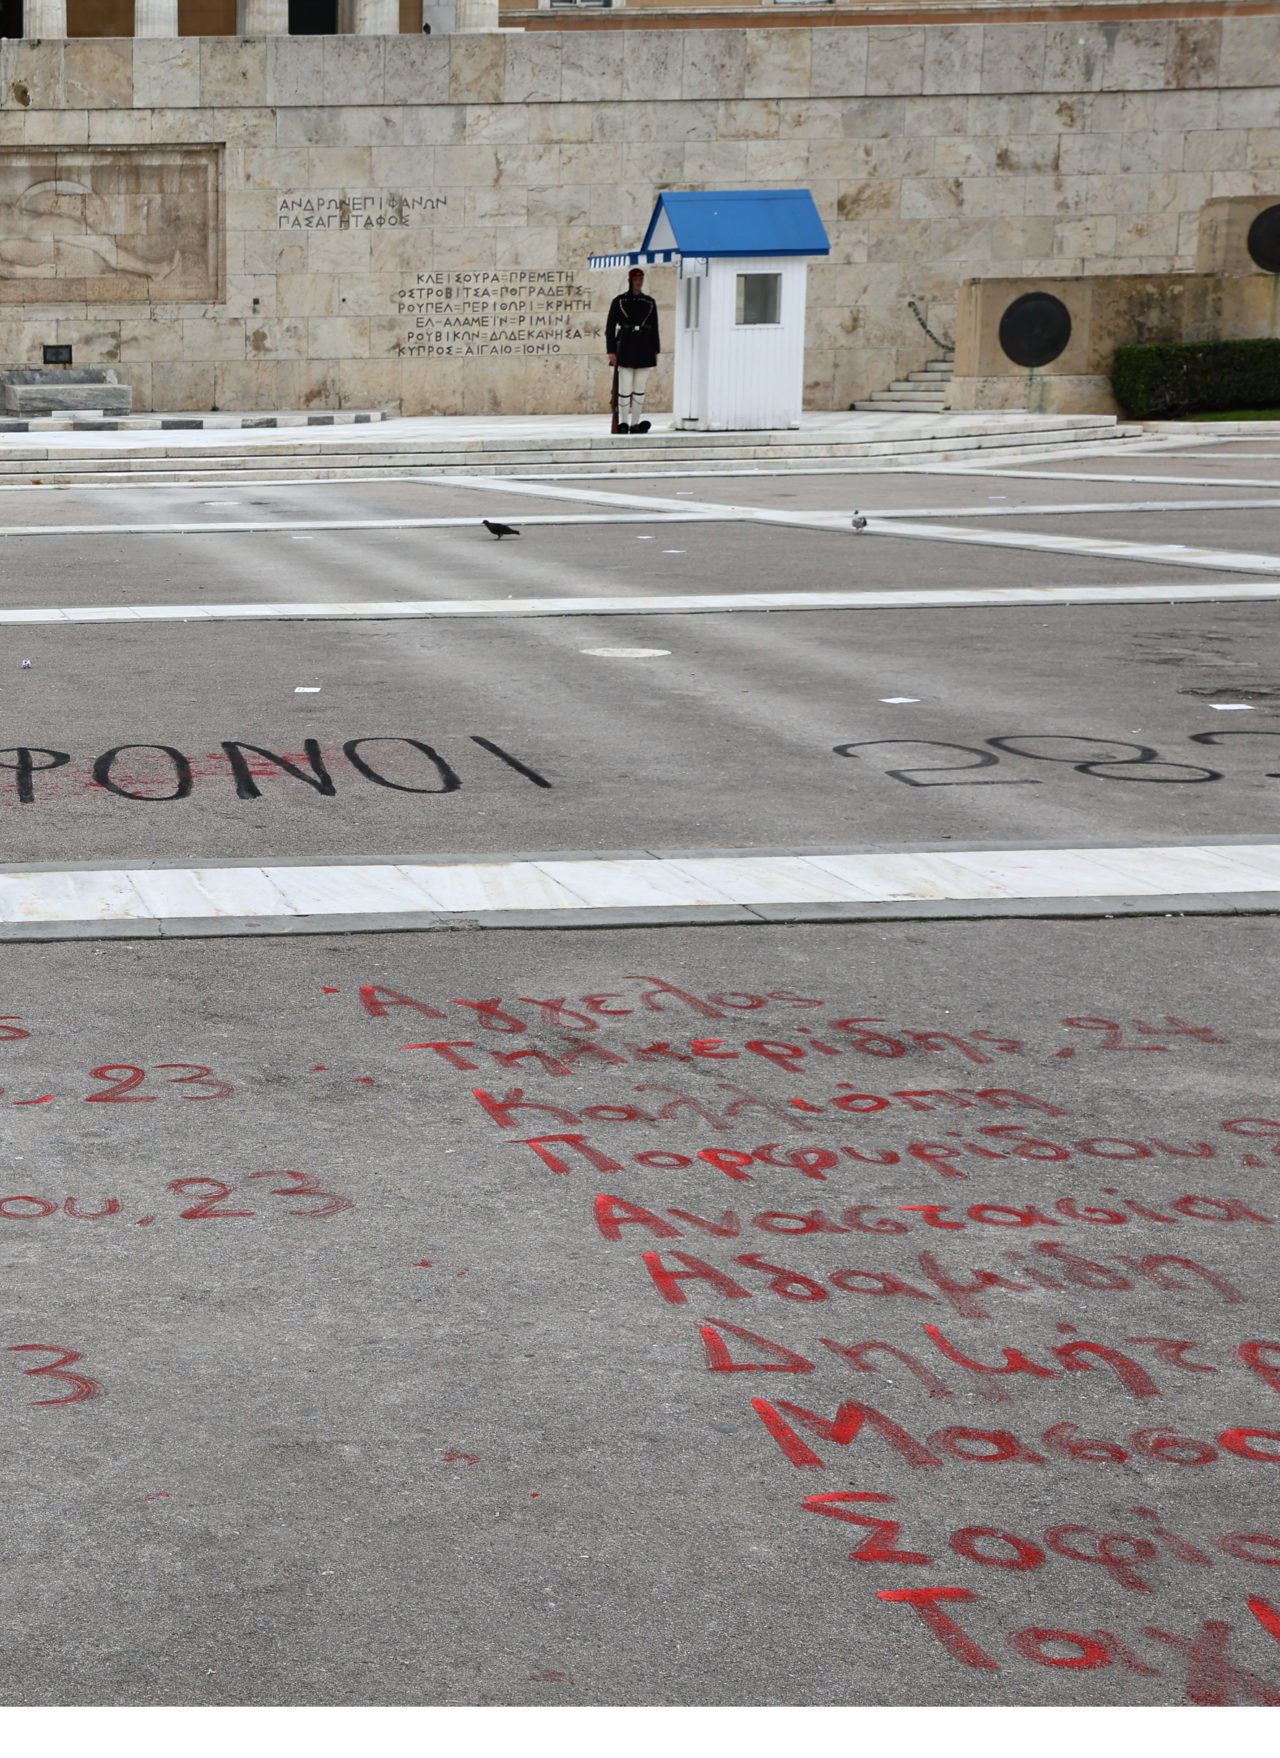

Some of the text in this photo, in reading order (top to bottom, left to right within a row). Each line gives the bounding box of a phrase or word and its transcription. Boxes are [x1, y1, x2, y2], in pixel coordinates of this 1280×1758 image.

[1061, 1016, 1232, 1052] 24
[84, 1064, 234, 1102] 23
[166, 1170, 354, 1220] 23
